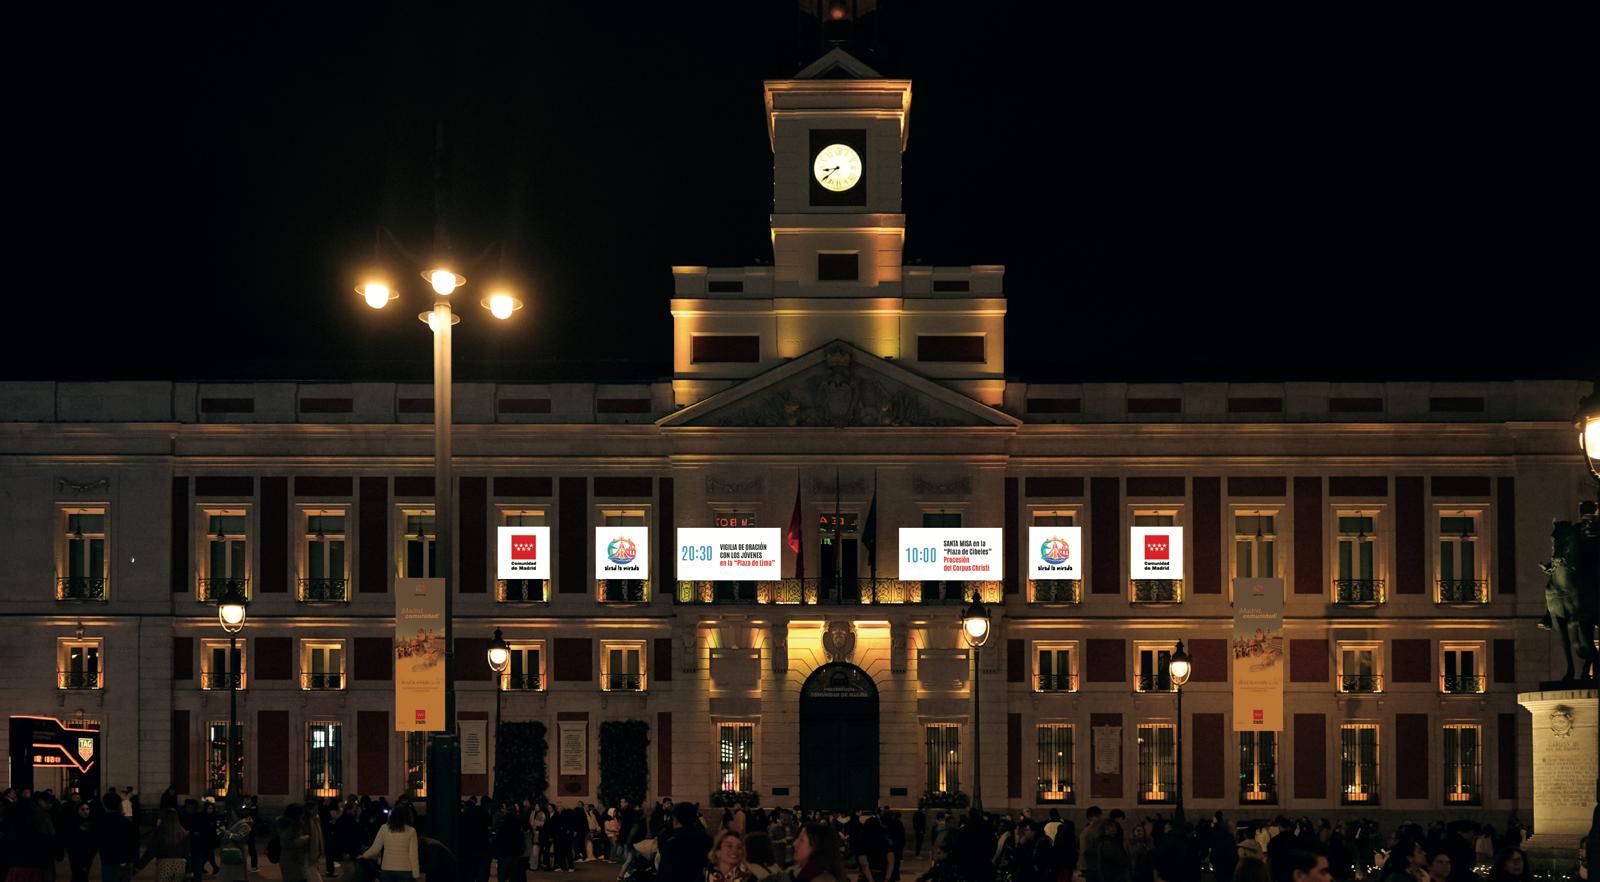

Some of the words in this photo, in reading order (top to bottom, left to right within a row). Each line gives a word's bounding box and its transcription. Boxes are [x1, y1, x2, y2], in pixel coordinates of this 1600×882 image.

[738, 543, 745, 551] DE
[745, 541, 767, 551] ORACIÓN
[682, 545, 713, 561] 20:30
[720, 551, 730, 559] CON
[731, 551, 740, 559] LOS
[740, 550, 762, 559] JÓVENES
[905, 547, 937, 563] 10:00
[953, 564, 971, 572] Corpus
[79, 740, 93, 748] TAG
